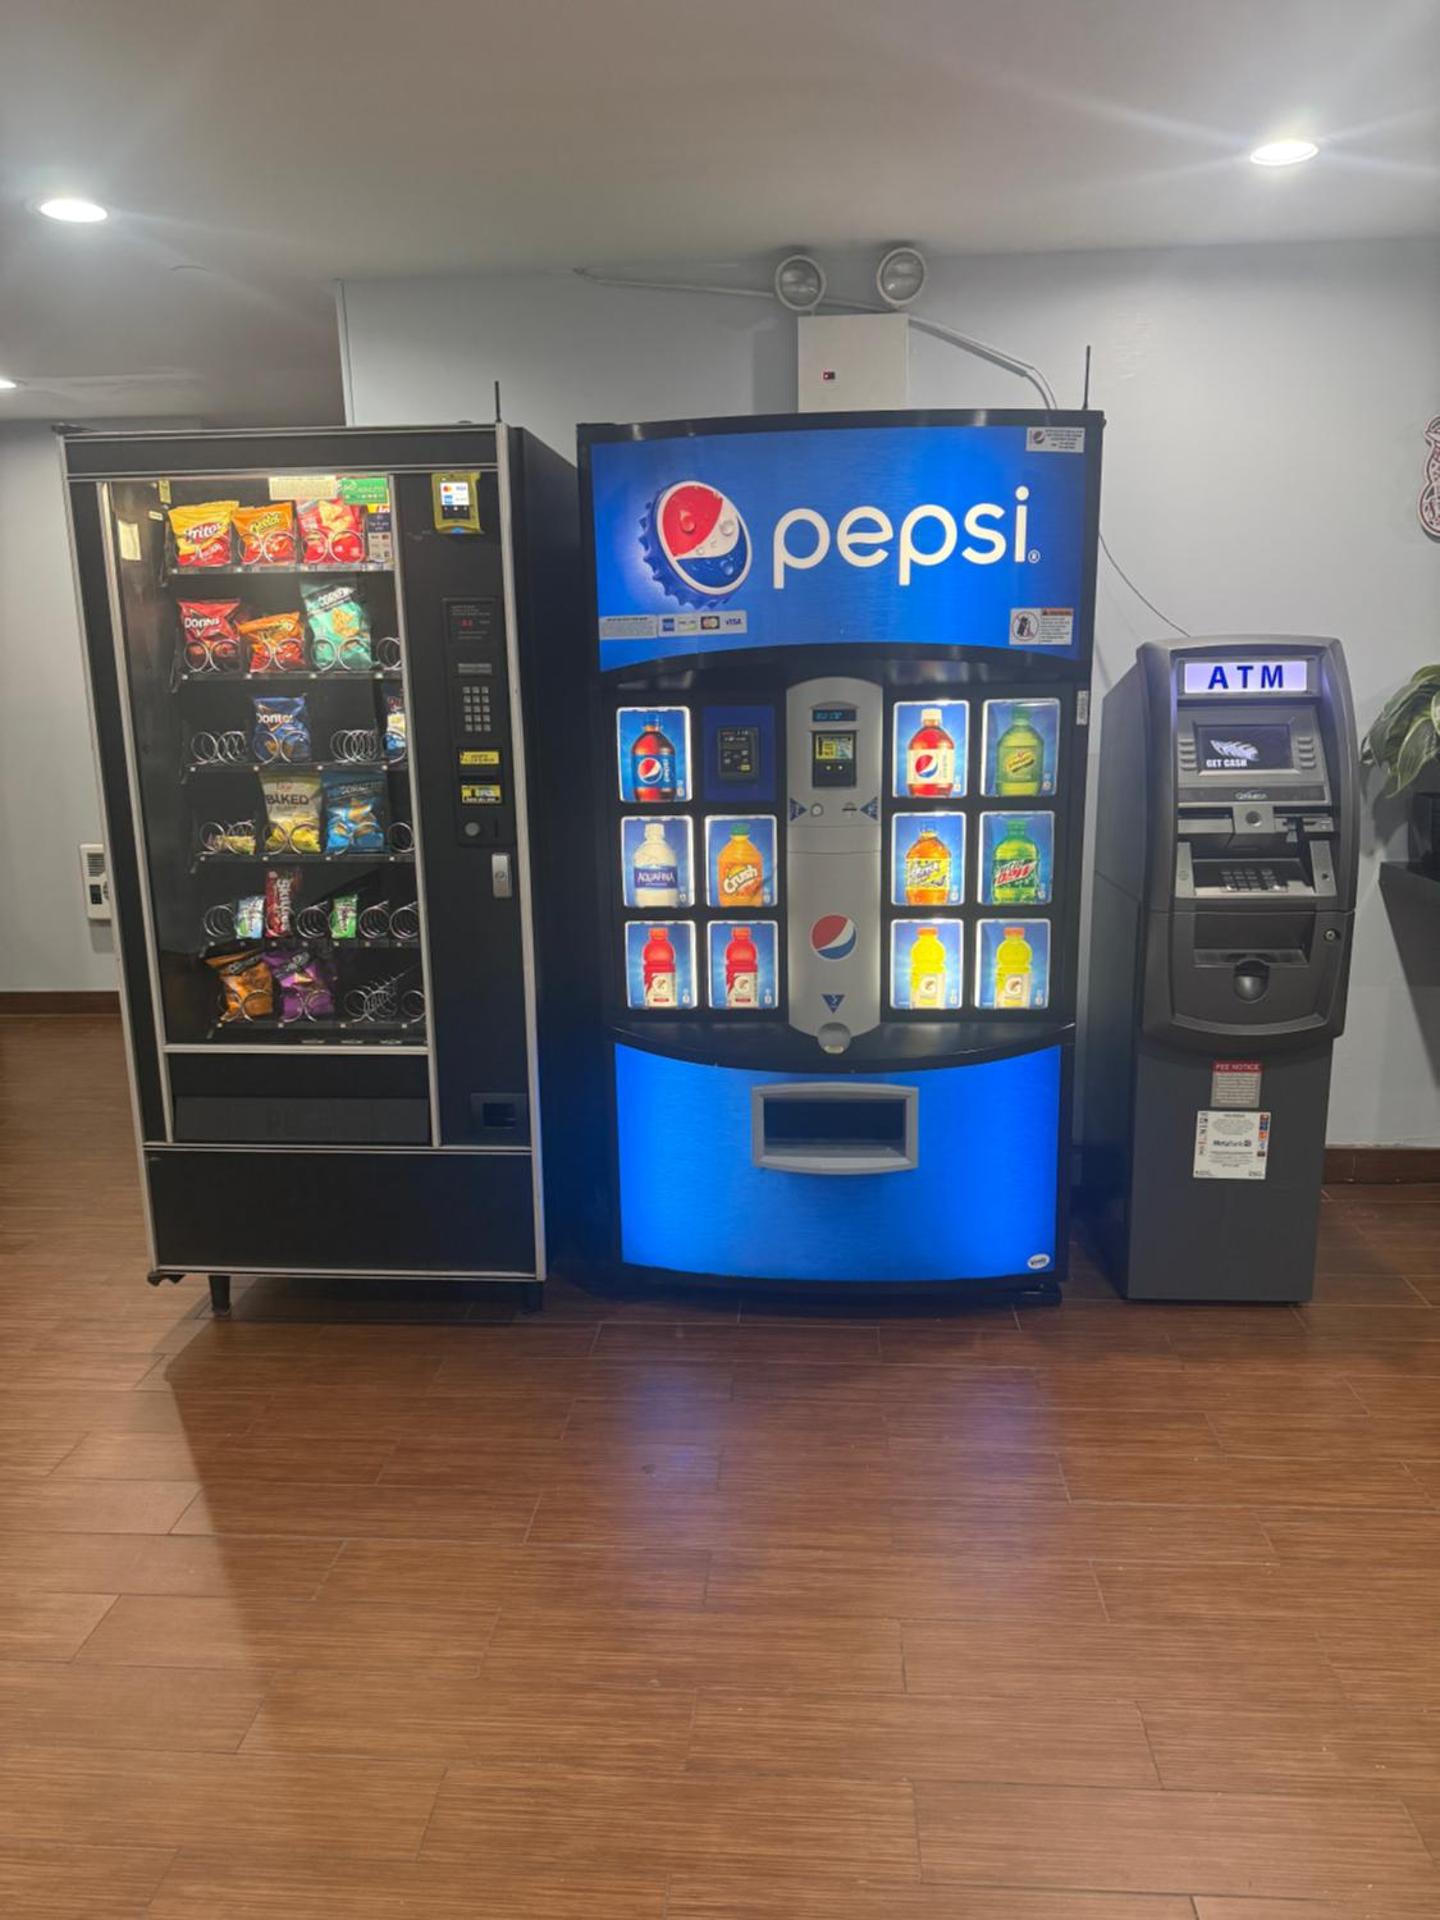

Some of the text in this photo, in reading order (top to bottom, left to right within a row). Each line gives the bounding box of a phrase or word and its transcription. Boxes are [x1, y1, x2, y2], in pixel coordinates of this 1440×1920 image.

[773, 485, 1030, 590] pepsi
[1207, 664, 1284, 689] ATM
[1224, 759, 1248, 768] CASH
[266, 794, 309, 806] BAKED
[723, 864, 758, 894] Crush
